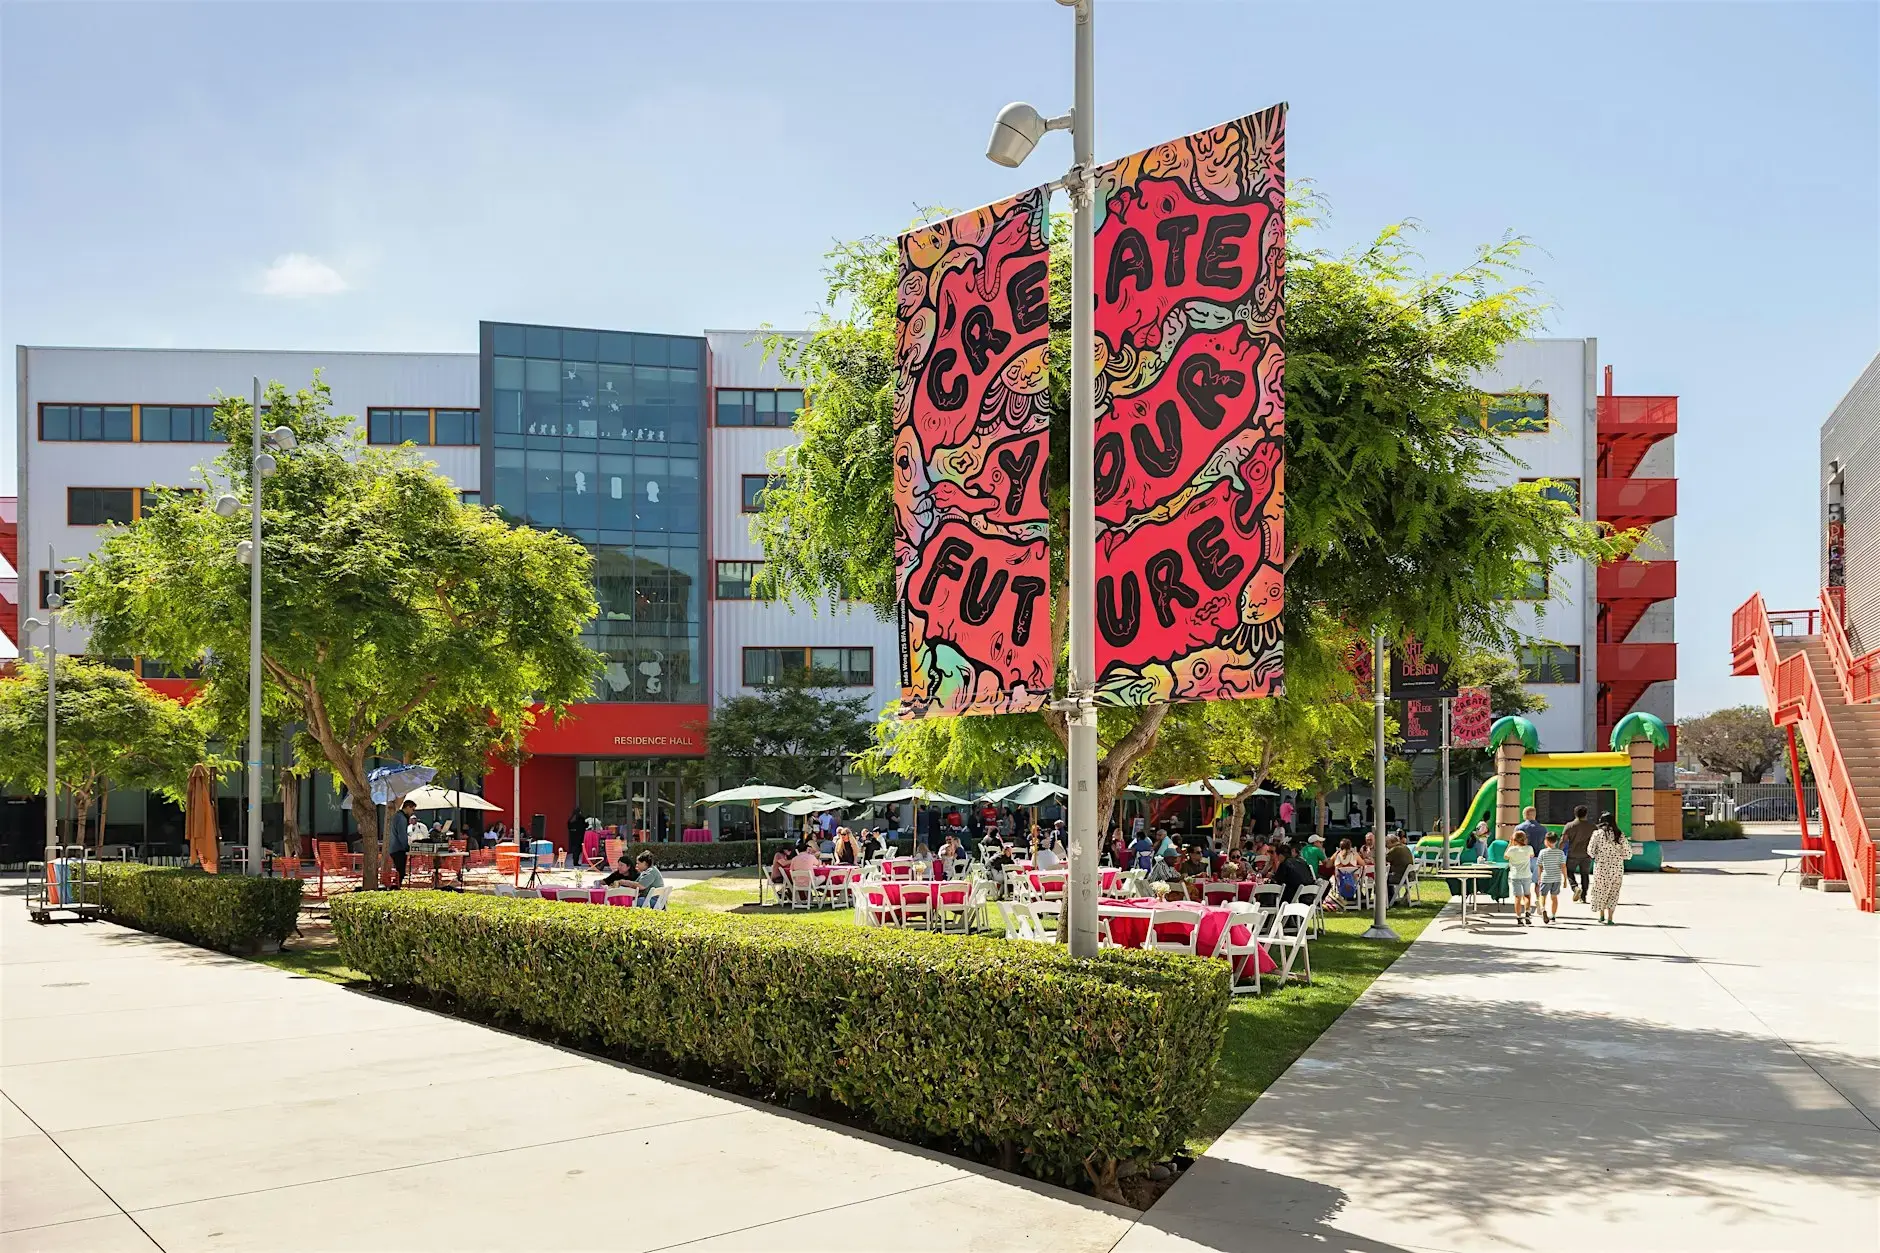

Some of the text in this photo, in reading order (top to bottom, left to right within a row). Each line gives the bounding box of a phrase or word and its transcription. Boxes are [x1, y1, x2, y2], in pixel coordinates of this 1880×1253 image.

[1402, 663, 1439, 676] DESIGN
[1456, 698, 1488, 712] CREATE
[1464, 710, 1487, 724] YOUR
[1454, 724, 1488, 737] FUTURE
[614, 736, 693, 745] RESIDENCE HALL
